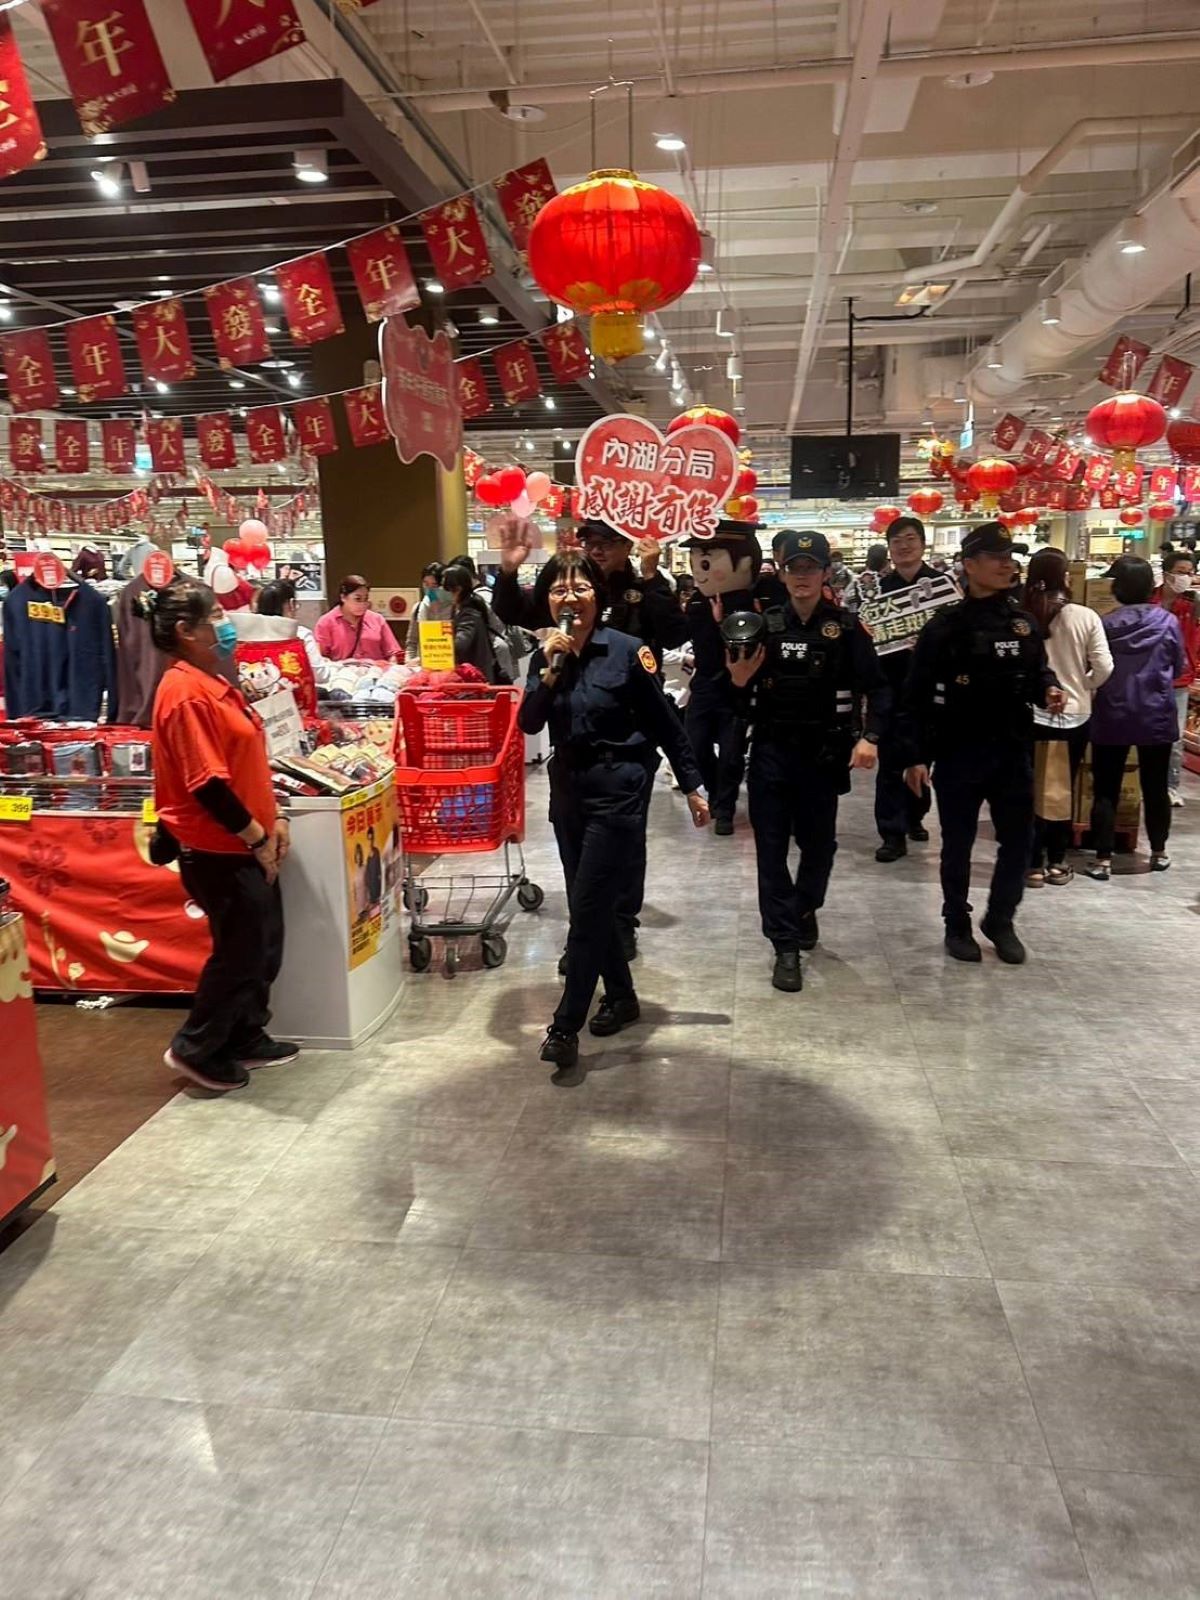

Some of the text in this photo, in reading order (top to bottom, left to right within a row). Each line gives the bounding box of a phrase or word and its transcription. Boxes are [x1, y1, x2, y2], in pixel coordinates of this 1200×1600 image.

[76, 10, 135, 77] 年
[439, 226, 475, 265] 大
[365, 254, 399, 290] 年
[297, 283, 328, 320] 全
[222, 304, 252, 339] 發
[152, 326, 180, 360] 大
[558, 339, 579, 365] 大
[17, 355, 45, 388] 全
[82, 342, 111, 376] 年
[505, 358, 528, 383] 年
[458, 377, 480, 400] 全
[304, 415, 327, 438] 年
[359, 405, 378, 426] 大
[62, 436, 82, 458] 全
[158, 434, 177, 455] 大
[206, 429, 226, 452] 發
[257, 423, 277, 446] 全
[111, 438, 128, 458] 年
[602, 437, 715, 480] 內湖分局
[583, 478, 718, 538] 感謝有您
[28, 603, 63, 622] 399
[860, 597, 902, 622] 行人
[781, 642, 808, 651] POLICE
[994, 640, 1020, 649] POLICE
[955, 674, 970, 685] 45
